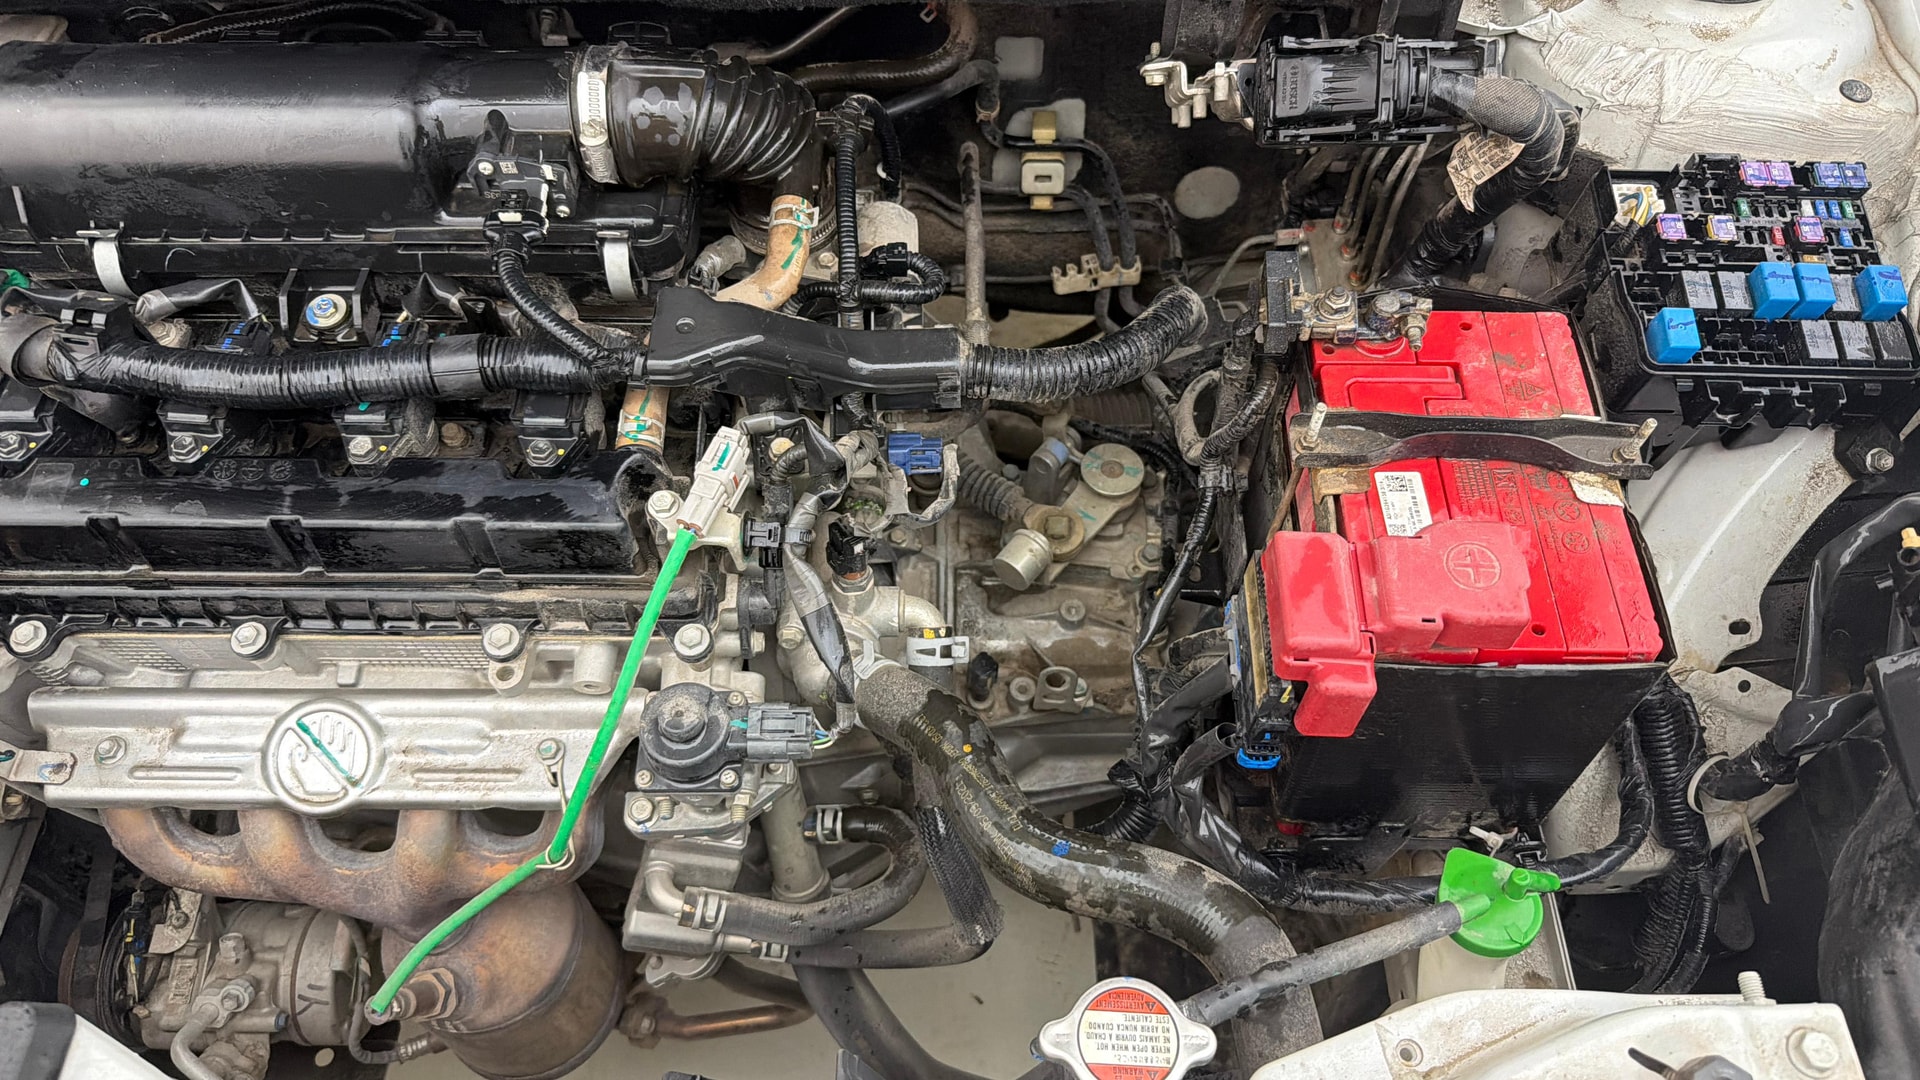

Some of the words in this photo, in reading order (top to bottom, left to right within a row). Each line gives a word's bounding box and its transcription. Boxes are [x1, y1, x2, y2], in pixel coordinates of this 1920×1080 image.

[1289, 76, 1298, 110] BOSCH
[1096, 1000, 1144, 1010] AVERTISSEMENT
[1156, 1015, 1170, 1024] ESTE
[1088, 1021, 1114, 1031] CUANDO
[1117, 1023, 1138, 1032] NUNCA
[1141, 1024, 1159, 1033] ABRIR
[1162, 1026, 1170, 1034] NO
[1115, 1033, 1137, 1042] OUVRIR
[1139, 1034, 1161, 1043] JAMAIS
[1163, 1035, 1171, 1044] NE
[1111, 1043, 1129, 1051] WHEN
[1132, 1044, 1148, 1053] OPEN
[1151, 1045, 1171, 1054] NEVER
[1112, 1066, 1144, 1076] WARNING
